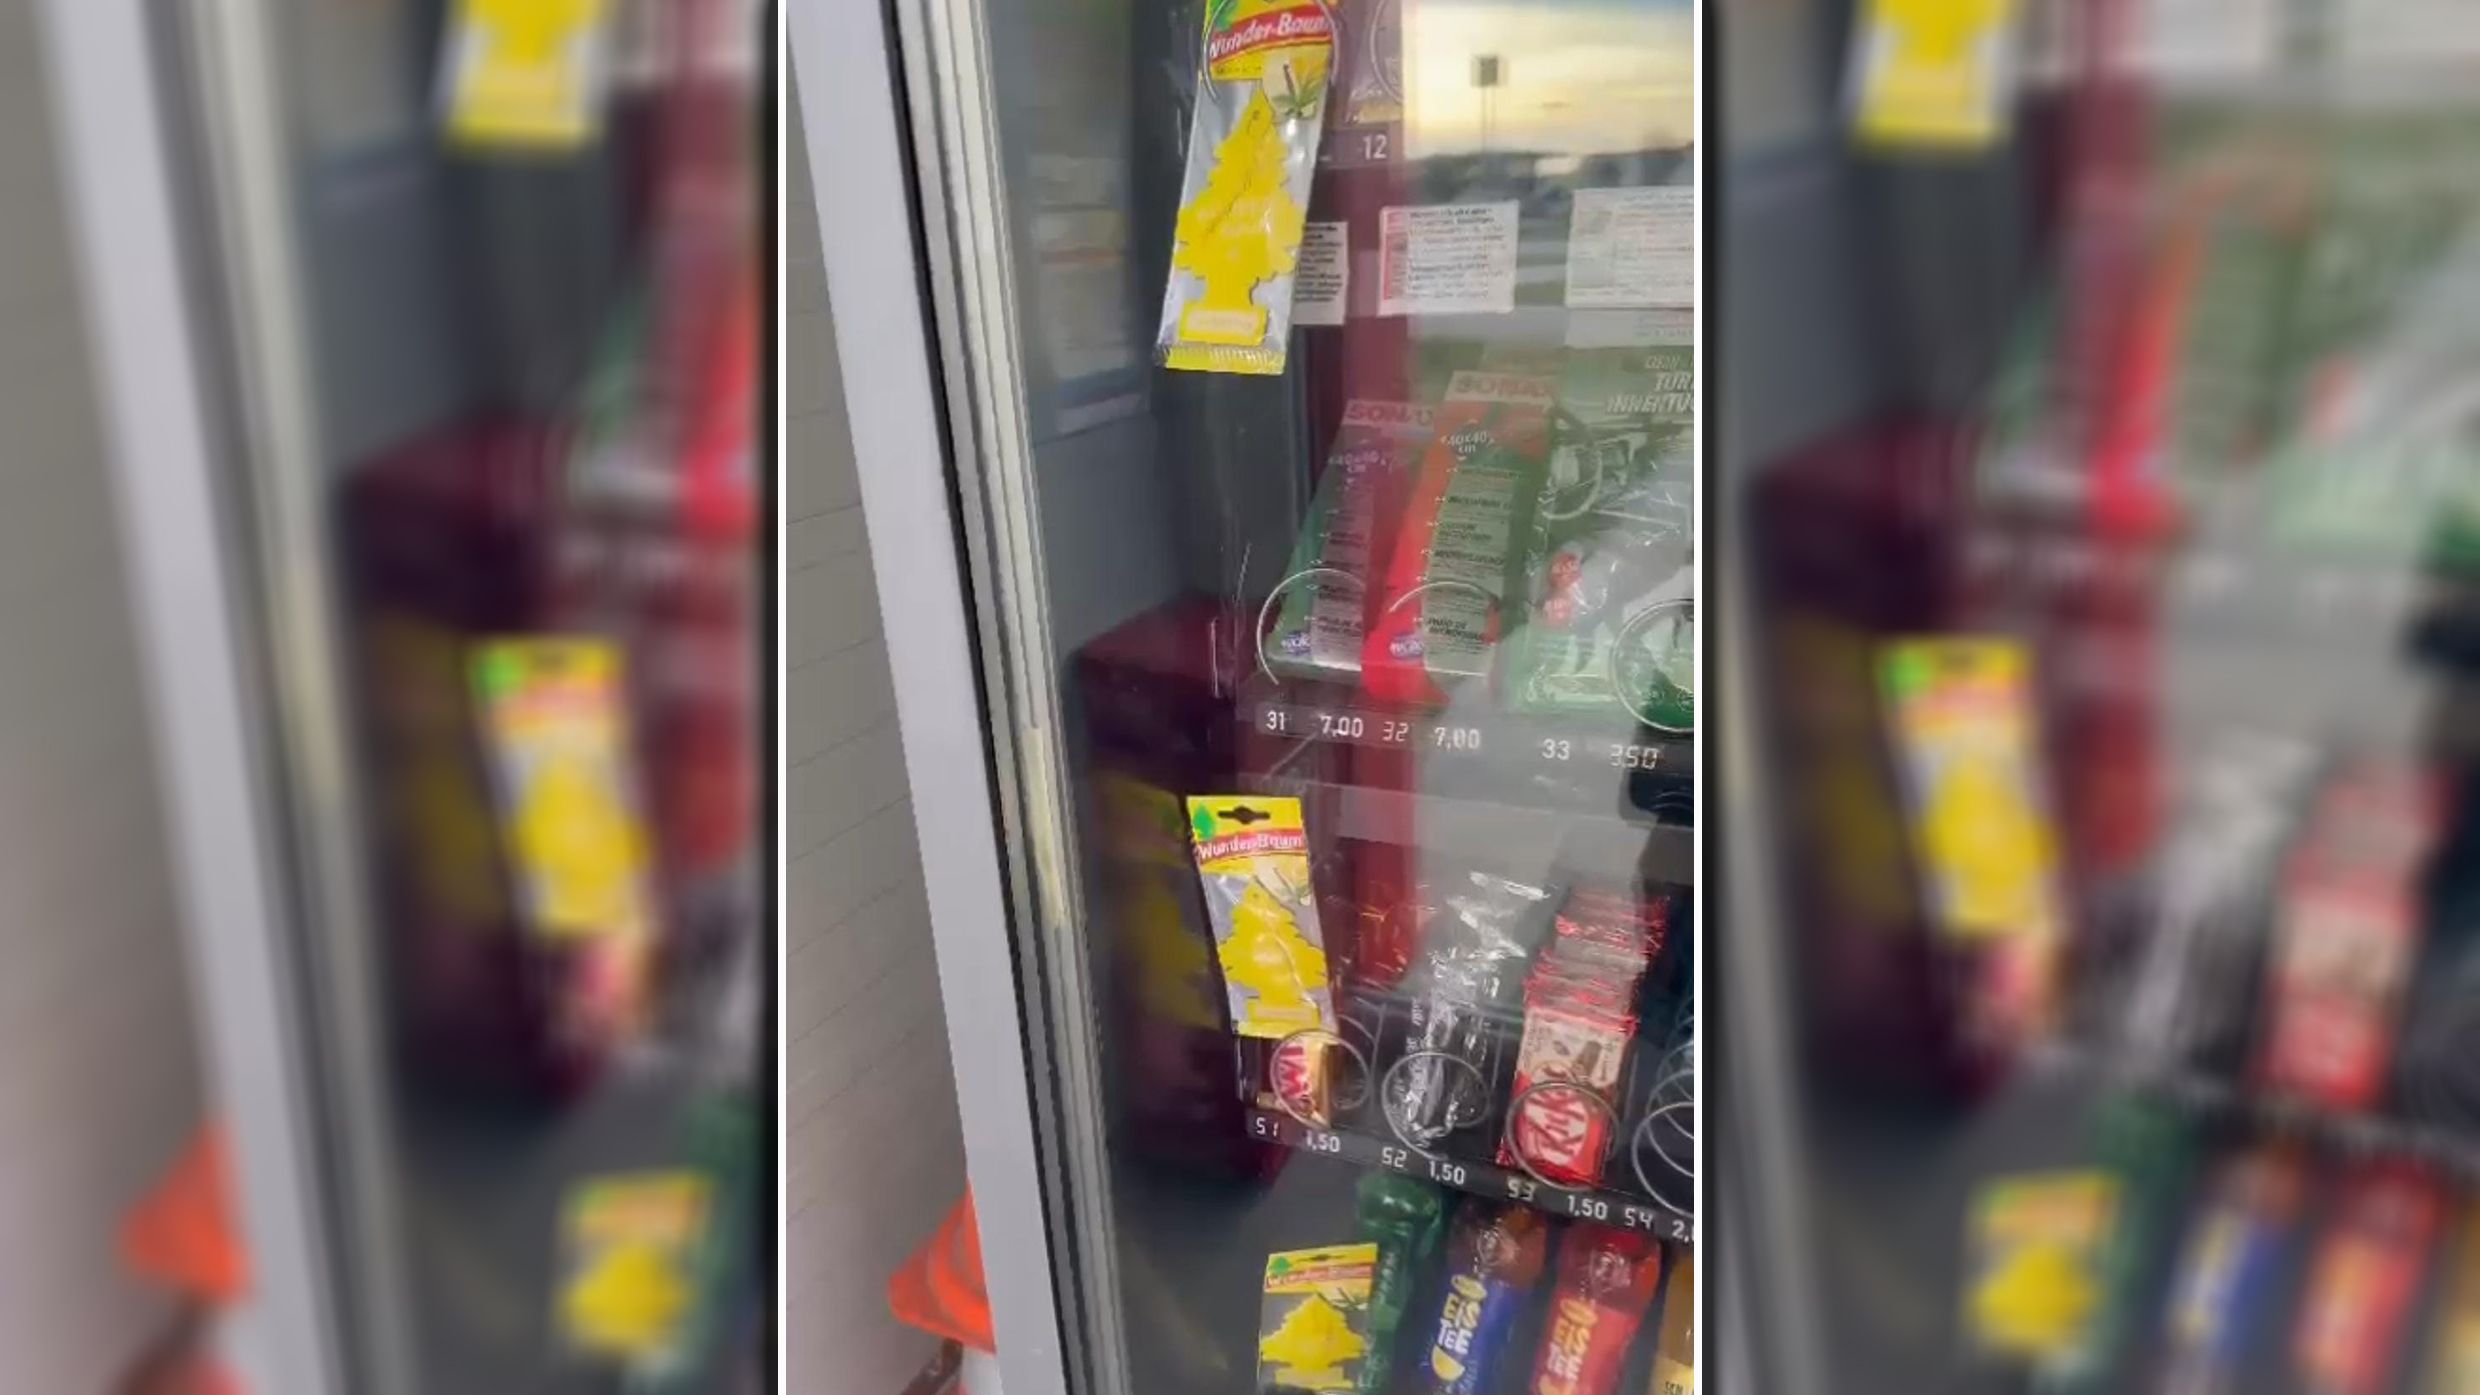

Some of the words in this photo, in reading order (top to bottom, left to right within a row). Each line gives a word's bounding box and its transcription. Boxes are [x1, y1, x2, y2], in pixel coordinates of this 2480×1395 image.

[1361, 134, 1387, 160] 12
[1266, 711, 1286, 731] 31
[1319, 715, 1364, 738] 7,00
[1382, 721, 1409, 742] 32
[1433, 726, 1480, 749] 7,00
[1541, 738, 1571, 761] 33
[1305, 1129, 1341, 1152] 1,50
[1429, 1160, 1466, 1185] 1,50
[1567, 1195, 1609, 1221] 1,50
[1672, 1220, 1694, 1243] 2,
